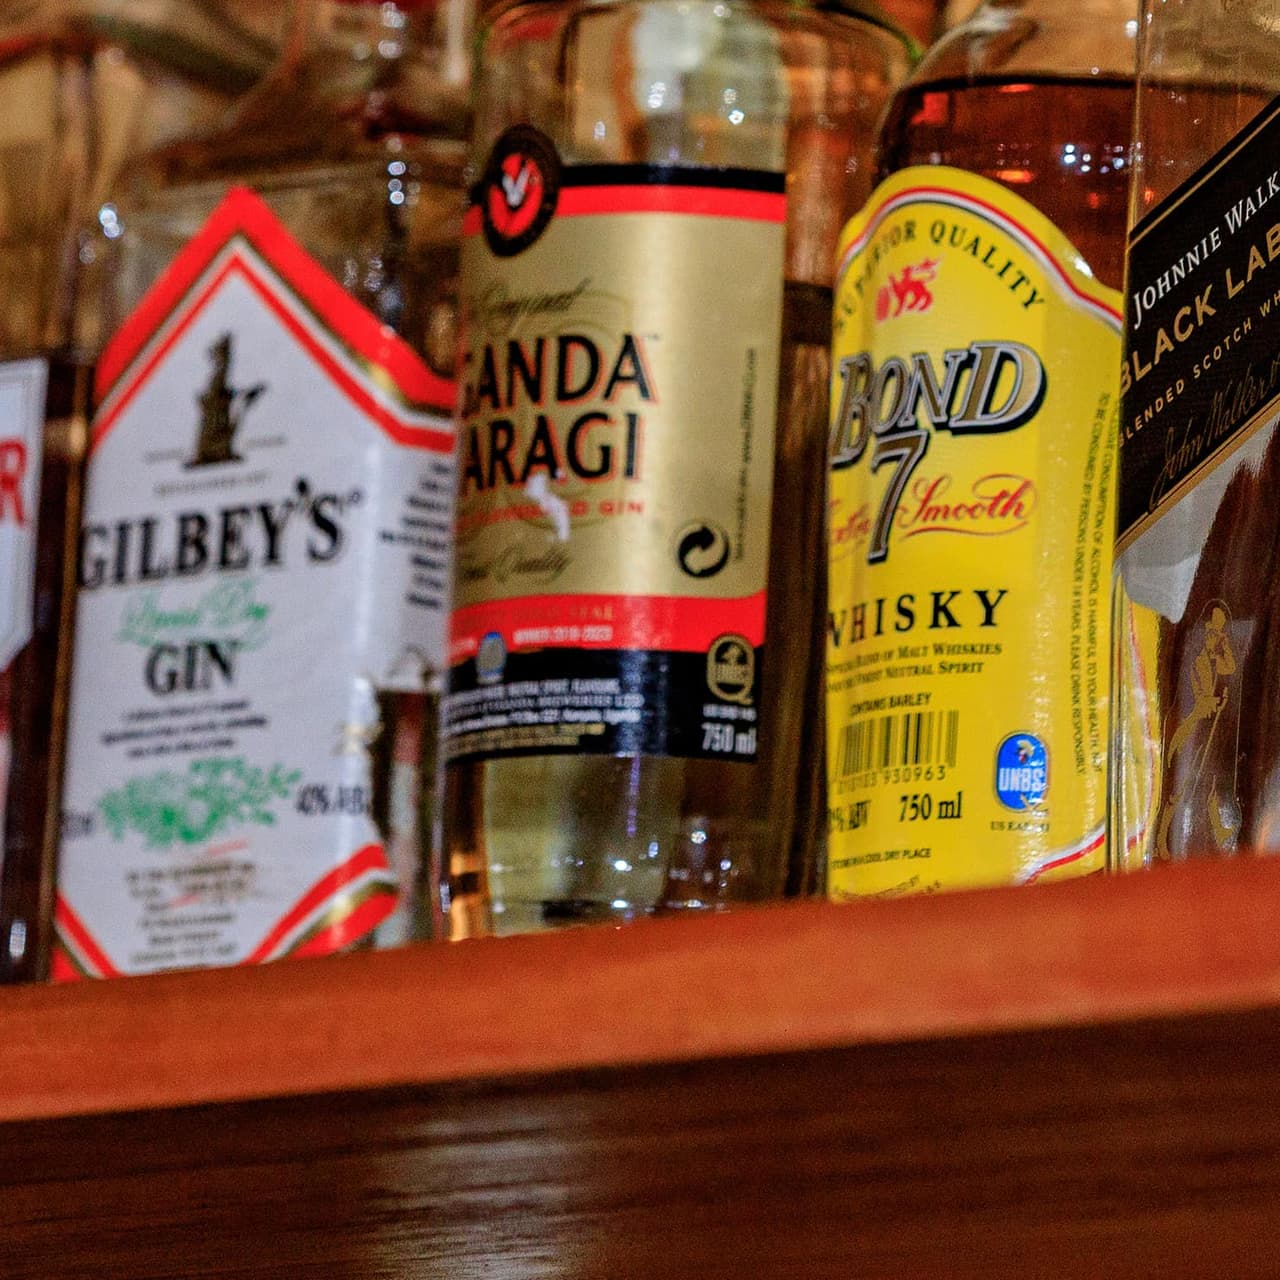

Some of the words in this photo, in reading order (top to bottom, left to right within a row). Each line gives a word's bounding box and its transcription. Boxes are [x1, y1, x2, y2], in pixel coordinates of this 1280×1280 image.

[929, 219, 1045, 310] QUALITY
[1132, 226, 1223, 331] JOHNNIE
[1120, 283, 1218, 401] BLACK
[1192, 316, 1253, 380] SCOTCH
[826, 339, 1048, 471] BOND
[1203, 362, 1270, 450] Walker
[867, 429, 930, 566] 7
[894, 472, 1040, 532] Smooth
[76, 474, 346, 590] GILBEY'S
[1076, 497, 1091, 544] PERSONS
[1073, 545, 1085, 583] UNDER
[1088, 546, 1102, 595] ALCOHOL
[145, 638, 240, 696] GIN
[932, 642, 1003, 657] WHISKIES
[938, 661, 985, 675] SPIRIT
[1070, 633, 1082, 671] PLEASE
[889, 691, 933, 709] BARLEY
[1070, 673, 1082, 706] DRINK
[1087, 677, 1098, 707] YOUR
[701, 721, 734, 753] 750
[734, 725, 757, 755] ml
[883, 764, 947, 785] 930963
[998, 766, 1044, 794] UNBS
[898, 792, 933, 823] 750
[936, 790, 964, 820] ml
[902, 847, 932, 860] PLACE
